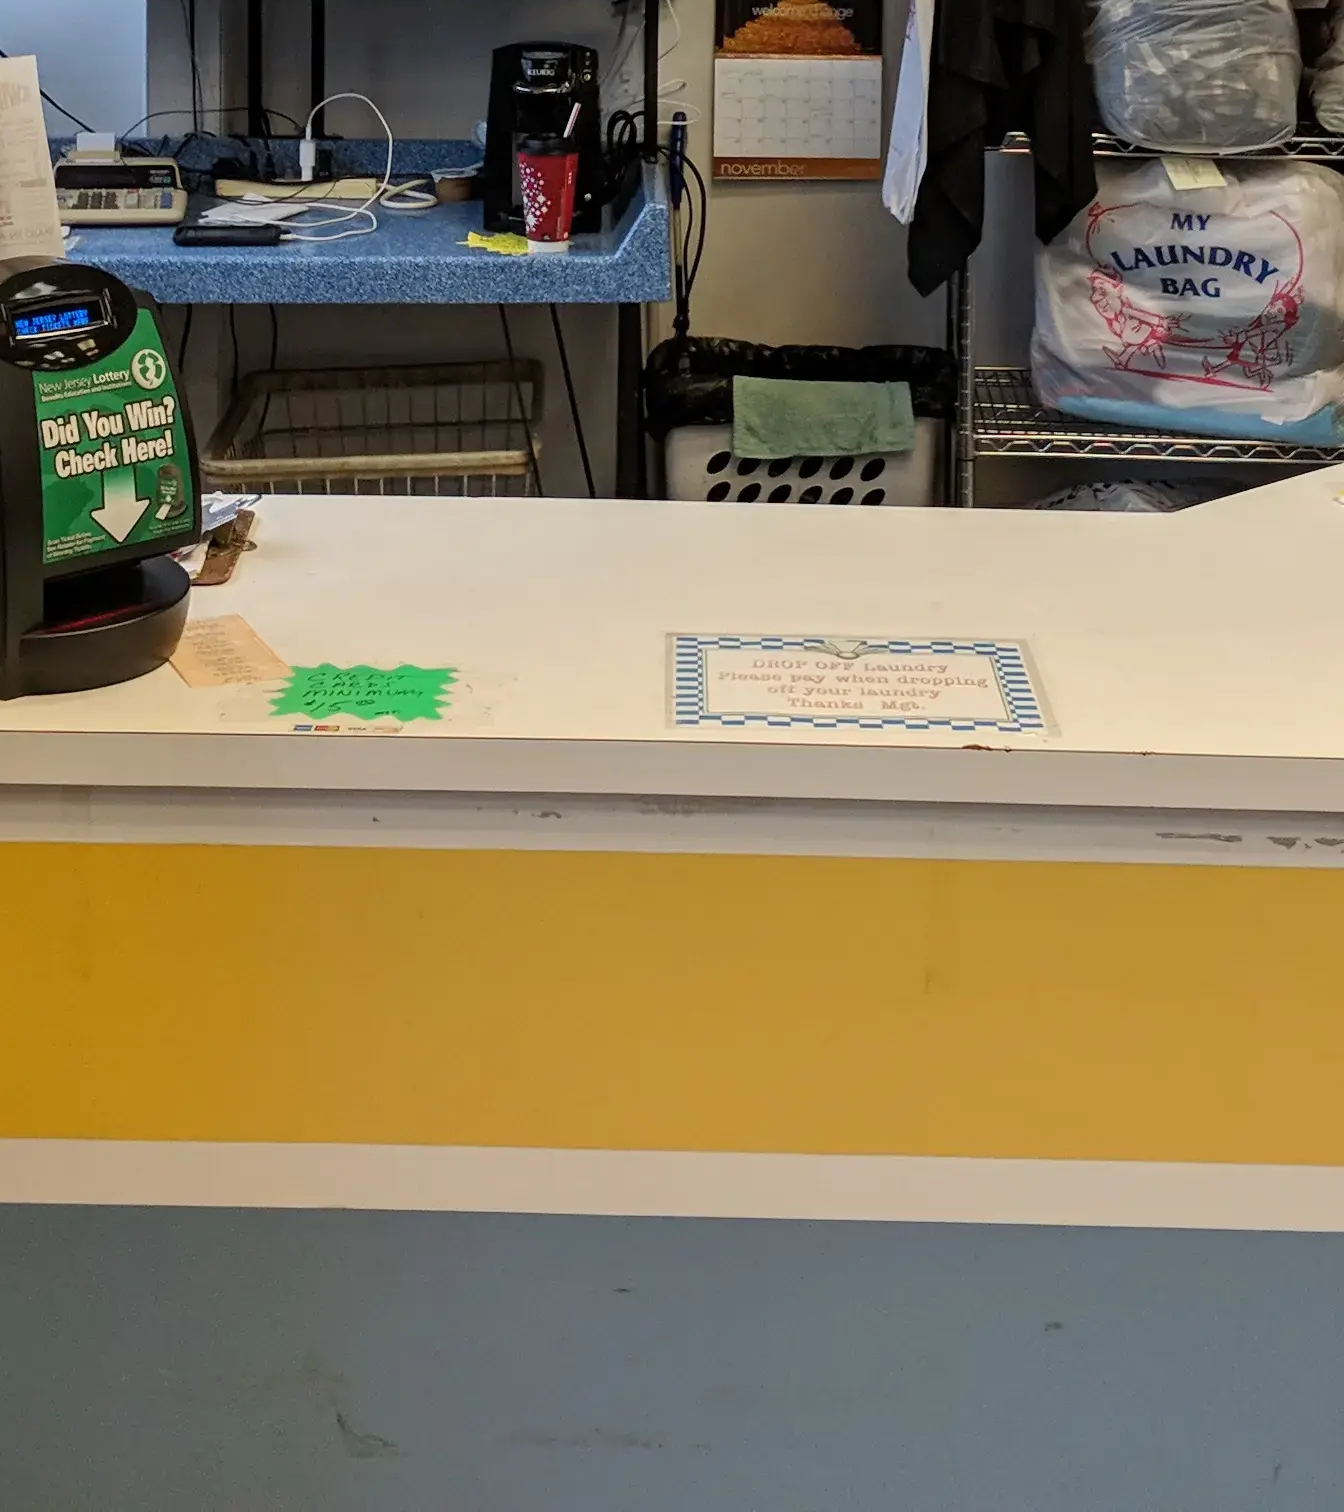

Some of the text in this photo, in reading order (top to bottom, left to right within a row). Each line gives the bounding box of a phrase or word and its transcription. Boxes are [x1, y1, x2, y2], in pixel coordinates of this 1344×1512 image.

[720, 161, 807, 176] november
[1171, 213, 1211, 231] MY
[1110, 245, 1279, 284] LAUNDRY
[1160, 277, 1221, 298] BAG
[39, 369, 131, 394] New Jersey Lottery
[40, 395, 176, 449] Did You Win?
[55, 429, 174, 479] Check Here!
[753, 659, 949, 675] DROP OFF Laundry
[718, 671, 988, 688] Please pay when dropping
[768, 686, 853, 699] off your
[786, 697, 926, 712] Thanks Mgt.
